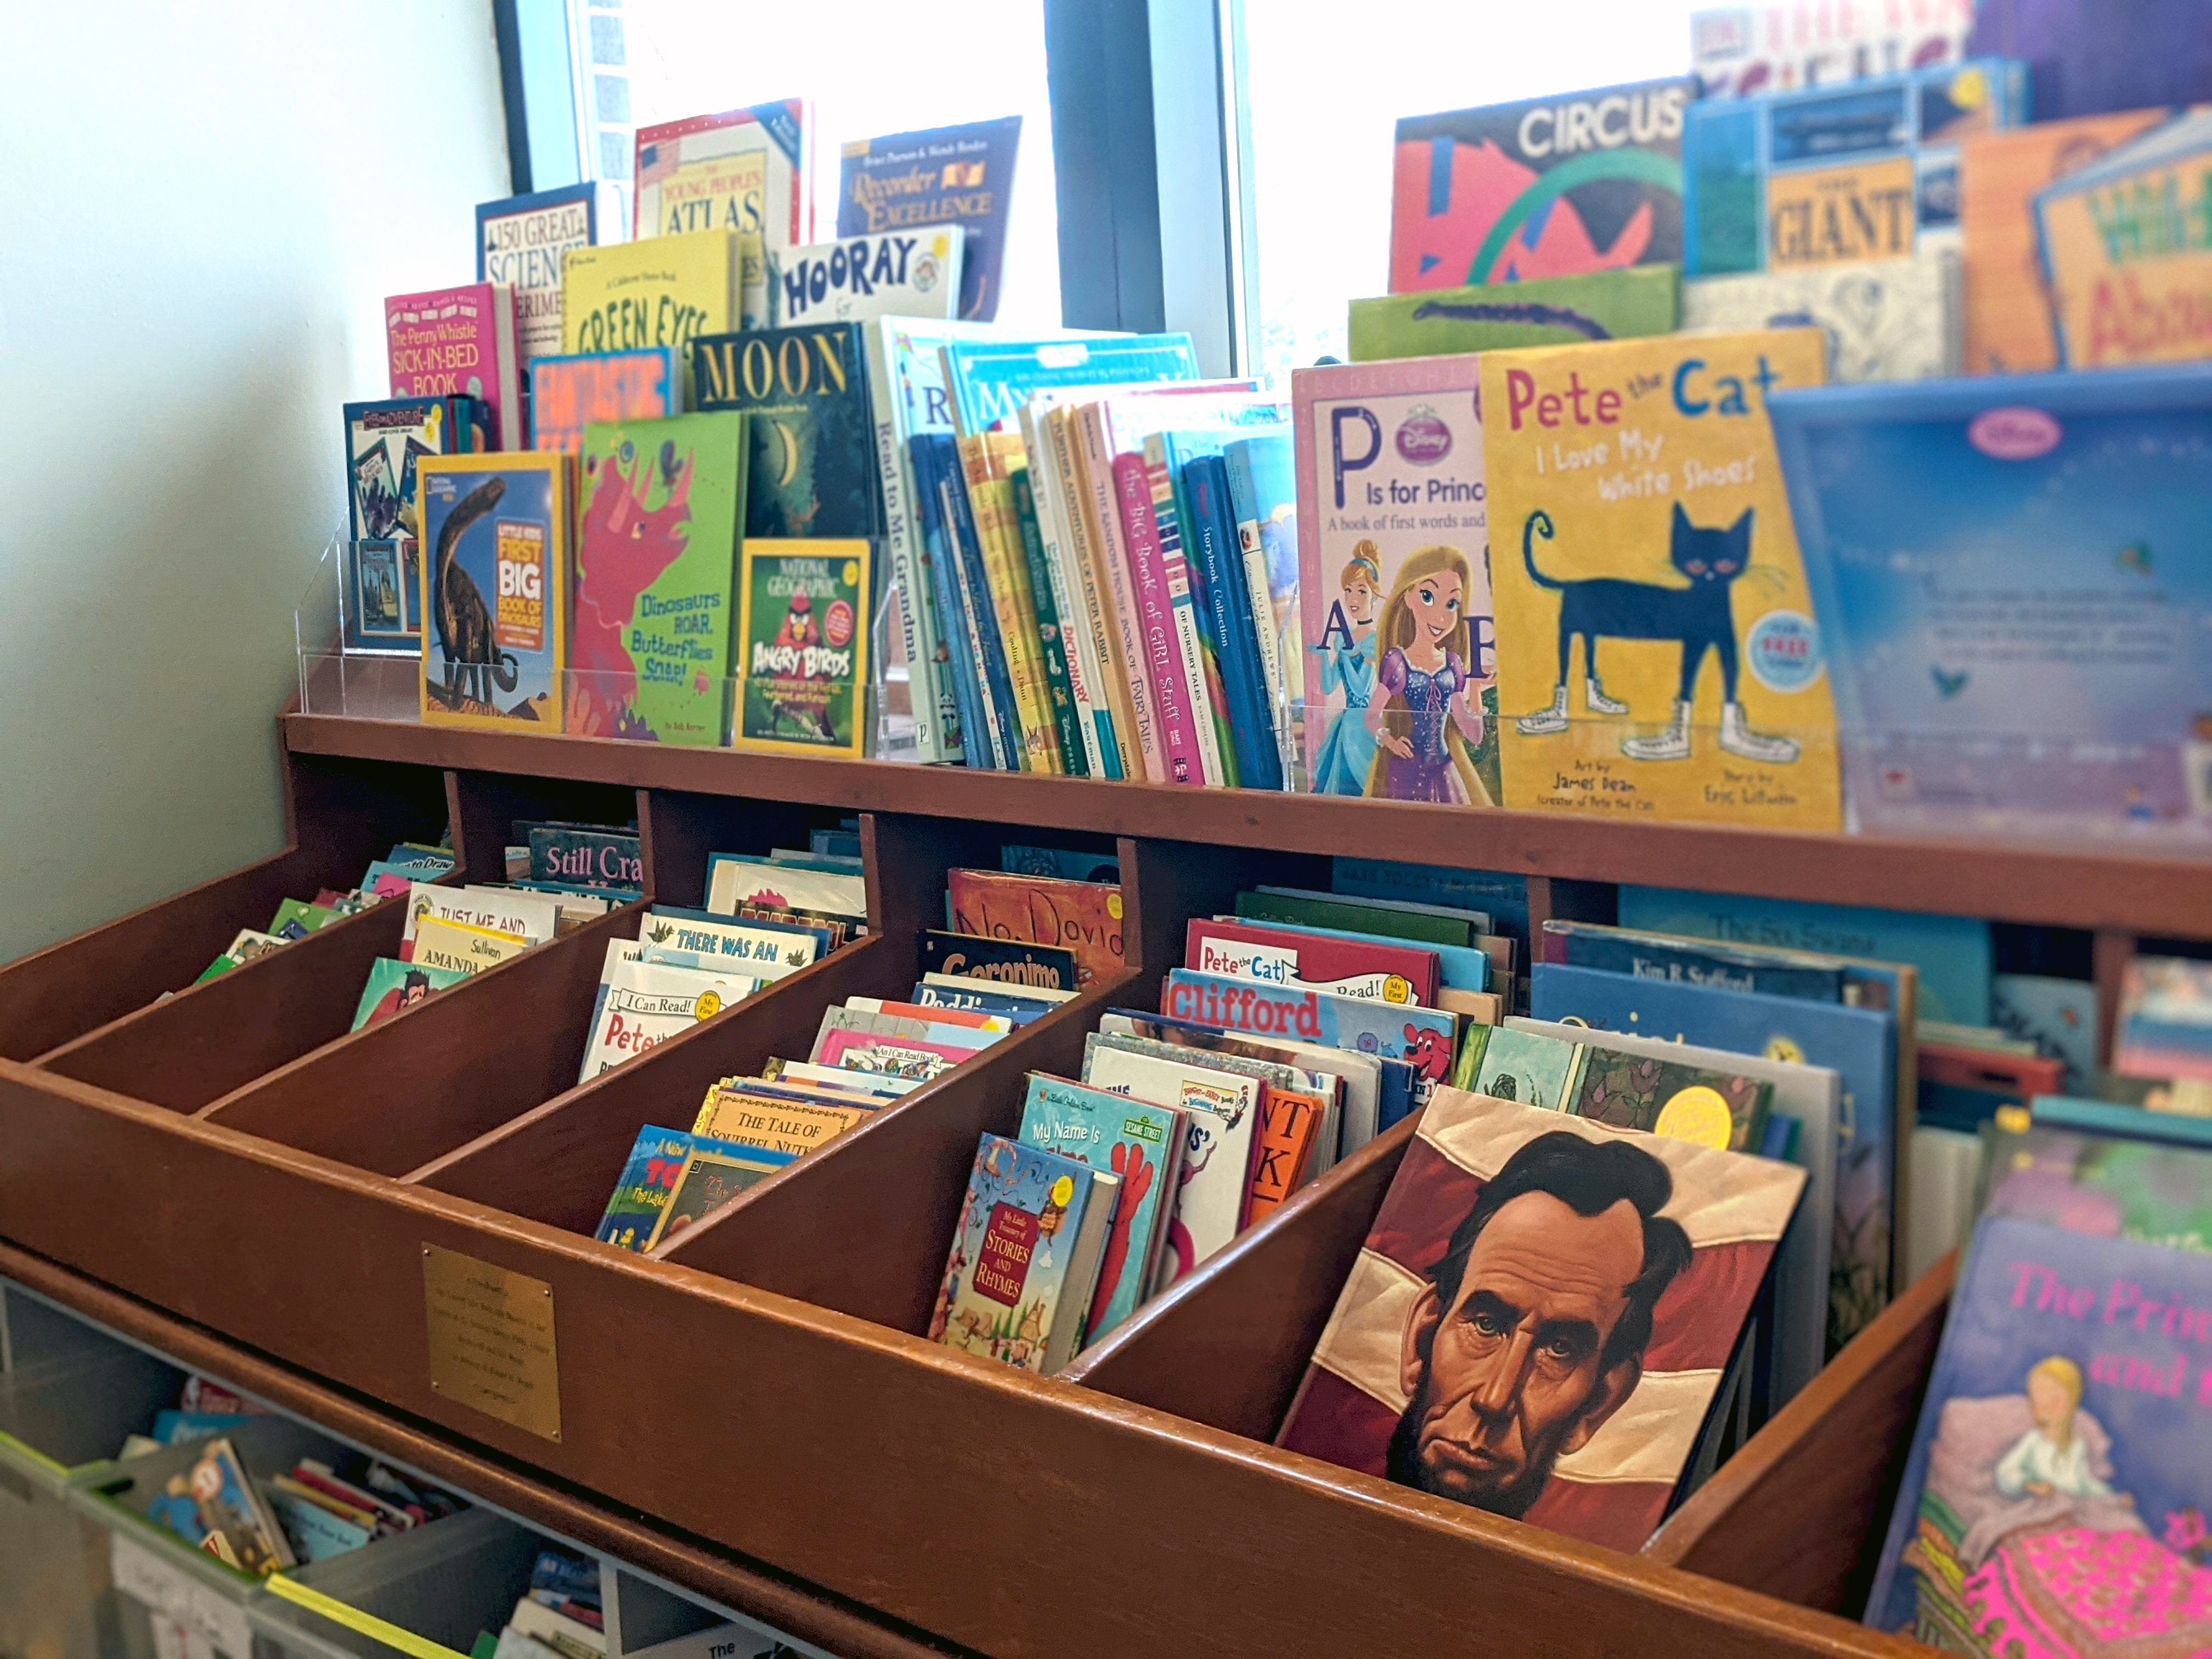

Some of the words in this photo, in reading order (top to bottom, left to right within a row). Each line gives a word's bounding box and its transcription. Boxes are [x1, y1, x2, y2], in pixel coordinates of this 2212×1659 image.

[1519, 87, 1689, 157] CIRCUS
[668, 190, 762, 236] ATLAS
[867, 192, 992, 232] EXCELLENCE
[1772, 187, 1910, 262] GIANT
[496, 221, 521, 251] 150
[524, 208, 578, 245] GREAT
[783, 237, 918, 319] HOORAY
[391, 330, 407, 346] The
[408, 327, 437, 347] Penny
[438, 323, 477, 341] Whistle
[579, 298, 647, 354] GREEN
[393, 343, 479, 374] SICK-IN-BED
[701, 332, 847, 404] MOON
[413, 373, 458, 396] BOOK
[1506, 369, 1623, 431] Pete
[1626, 374, 1664, 399] the
[1673, 356, 1782, 417] Cat
[878, 422, 894, 482] Read
[1400, 426, 1449, 451] Disney
[1554, 441, 1609, 471] Love
[1619, 429, 1664, 462] My
[1331, 406, 1381, 510] P
[1096, 481, 1108, 509] THE
[1367, 482, 1383, 505] Is
[1389, 479, 1421, 504] for
[1598, 470, 1671, 501] White
[1683, 456, 1757, 492] Shoes
[885, 486, 896, 508] to
[890, 514, 904, 549] Me
[1064, 481, 1090, 561] ADVENTURES
[1328, 517, 1337, 532] A
[1339, 516, 1370, 531] book
[1373, 515, 1387, 530] of
[1389, 514, 1417, 530] first
[1419, 513, 1459, 528] words
[1461, 512, 1485, 527] and
[499, 537, 543, 563] FIRST
[1101, 511, 1120, 569] RANDOM
[499, 560, 541, 600] BIG
[779, 558, 829, 576] NATIONAL
[1082, 562, 1093, 578] OF
[768, 575, 839, 599] GEOGRAPHIC
[1084, 581, 1102, 620] PETER
[1113, 571, 1127, 614] HOUSE
[1201, 525, 1222, 584] Storybook
[1212, 588, 1233, 647] Collection
[499, 596, 526, 614] BOOK
[528, 601, 542, 615] OF
[641, 592, 720, 618] Dinosaurs
[897, 555, 916, 663] Grandma
[1145, 600, 1164, 620] of
[1180, 610, 1188, 623] OF
[1121, 618, 1135, 654] BOOK
[1319, 599, 1355, 651] A
[631, 630, 713, 660] Butterflies
[752, 641, 802, 676] ANGRY
[803, 646, 850, 679] BIRDS
[1007, 631, 1022, 665] Cooling
[1092, 620, 1111, 666] RABBIT
[1182, 624, 1197, 670] NURSERY
[1127, 656, 1138, 670] OF
[1059, 624, 1090, 705] DICTIONARY
[1082, 720, 1099, 770] Eastman
[1130, 676, 1149, 718] FAIRY
[1190, 671, 1202, 701] TALES
[1058, 714, 1075, 746] Disney
[1137, 715, 1156, 754] TALES
[1553, 772, 1595, 790] James
[1602, 776, 1635, 792] Dean
[423, 856, 454, 870] Draw
[546, 847, 592, 876] Still
[424, 950, 479, 974] AMANDA
[471, 940, 501, 959] Sullivan
[678, 929, 717, 954] THERE
[721, 936, 751, 959] WAS
[753, 943, 778, 962] AN
[1204, 946, 1239, 973] Pete
[1239, 956, 1251, 968] the
[1251, 956, 1282, 980] Cat
[1633, 958, 1666, 980] Kim
[626, 995, 634, 1008] I
[635, 996, 656, 1012] Can
[658, 1000, 691, 1013] Read!
[1170, 982, 1321, 1037] Clifford
[604, 1013, 654, 1053] Pete
[893, 1048, 903, 1057] Can
[904, 1051, 919, 1060] Read
[919, 1053, 935, 1062] Book
[738, 1112, 765, 1131] THE
[768, 1116, 802, 1136] TALE
[803, 1124, 822, 1139] OF
[1034, 1123, 1051, 1143] My
[1054, 1121, 1087, 1140] Name
[1091, 1125, 1100, 1143] Is
[1126, 1121, 1143, 1133] SESAME
[1144, 1127, 1161, 1139] STREET
[986, 1229, 1030, 1264] STORIES
[976, 1262, 1020, 1297] RHYMES
[994, 1259, 1011, 1272] AND
[2008, 1262, 2095, 1321] The
[2089, 1350, 2186, 1402] and
[710, 1640, 735, 1659] The
